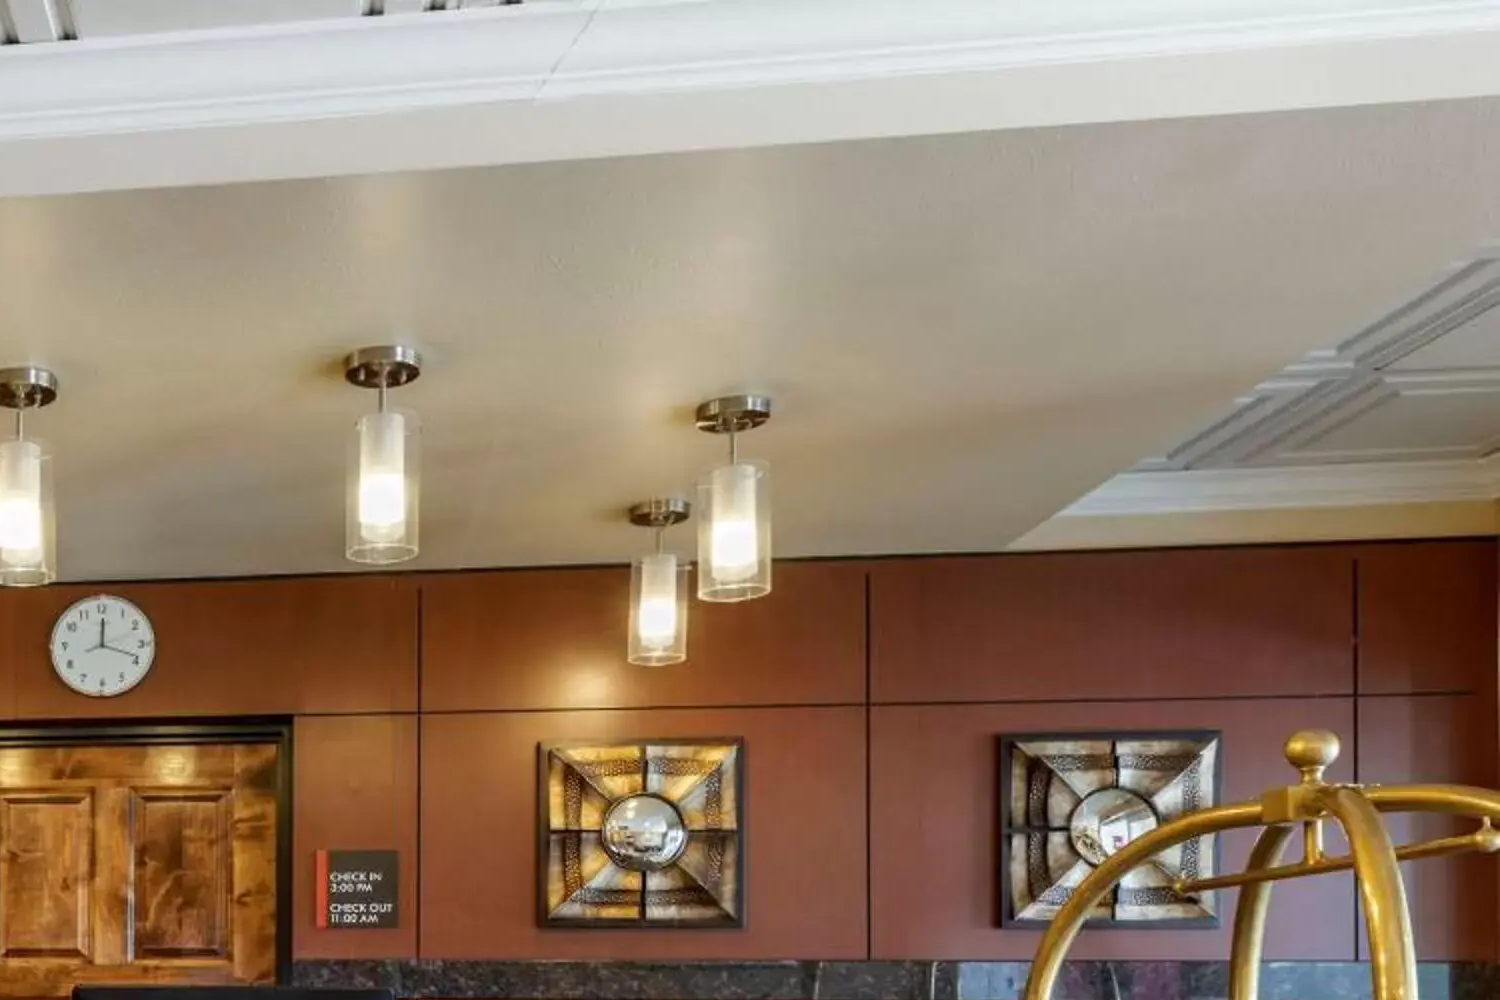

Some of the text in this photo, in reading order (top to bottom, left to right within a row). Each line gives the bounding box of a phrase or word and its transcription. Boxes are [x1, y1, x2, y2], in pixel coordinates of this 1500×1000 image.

[96, 604, 107, 614] 12
[79, 609, 90, 620] 11
[66, 621, 77, 632] 10
[131, 619, 140, 631] 2
[61, 641, 69, 651] 9
[137, 639, 145, 649] 3
[66, 659, 74, 669] 8
[132, 655, 140, 666] 4
[80, 673, 88, 683] 7
[329, 871, 383, 881] CHECK IN
[329, 883, 373, 893] 3:00 PM
[329, 903, 393, 913] CHECK OUT
[359, 914, 379, 923] AM
